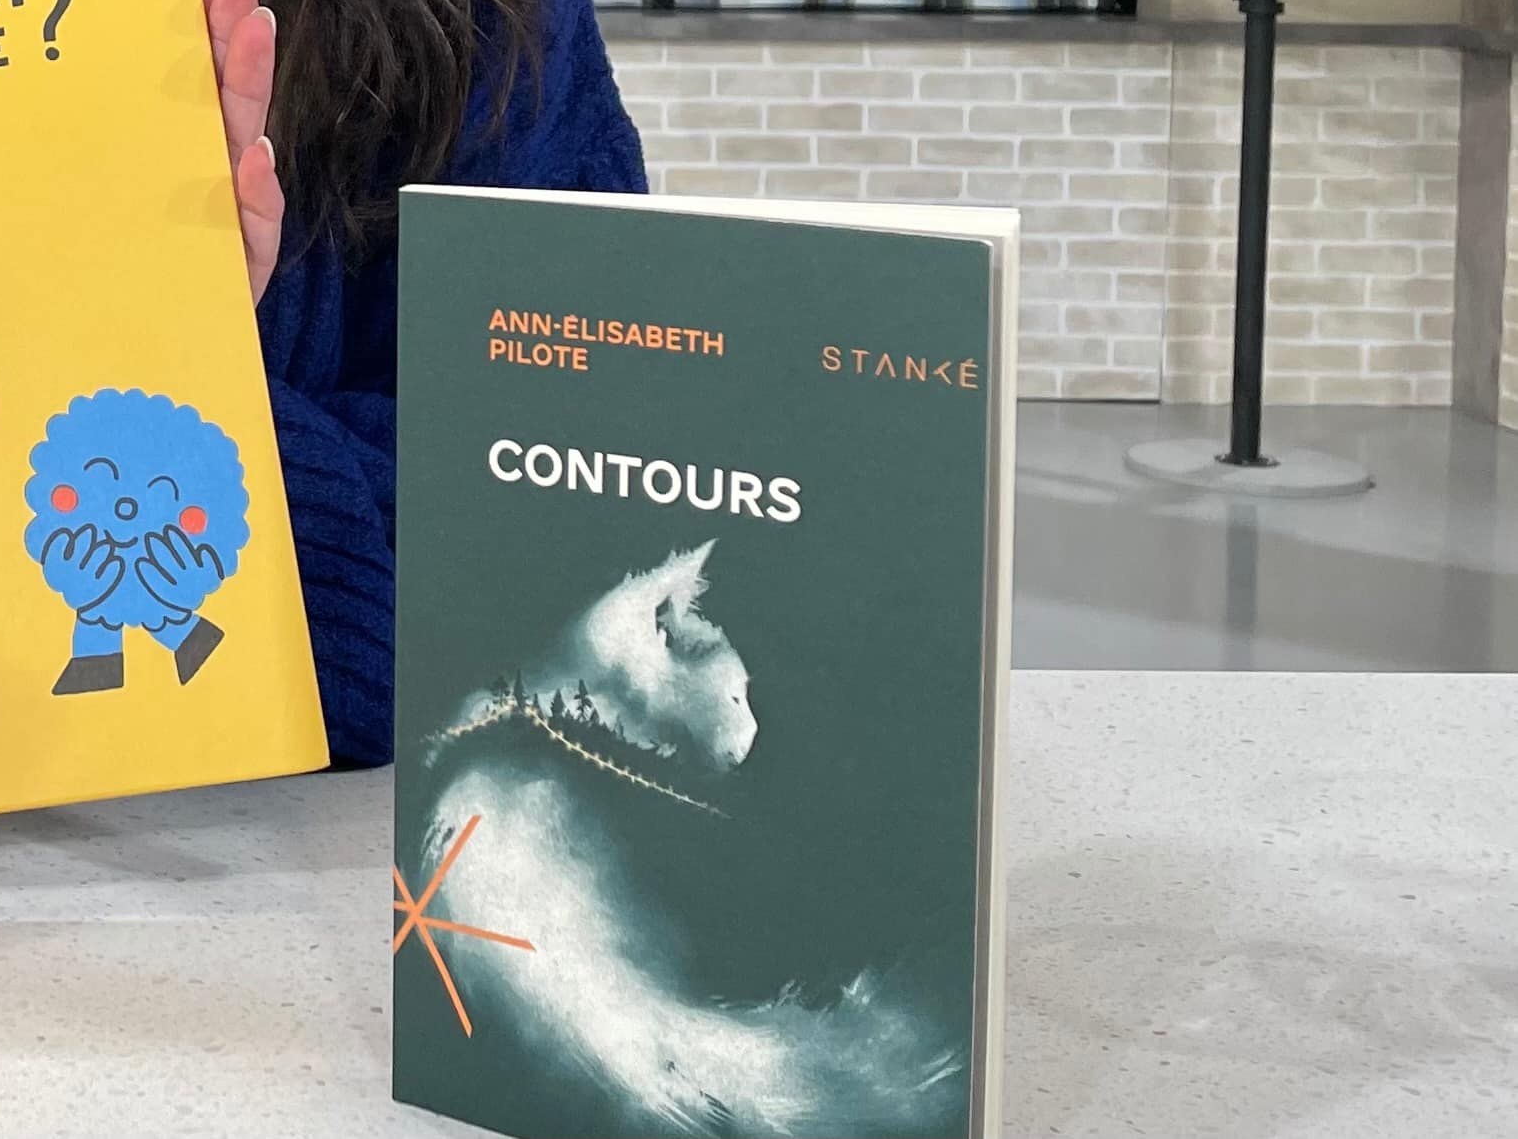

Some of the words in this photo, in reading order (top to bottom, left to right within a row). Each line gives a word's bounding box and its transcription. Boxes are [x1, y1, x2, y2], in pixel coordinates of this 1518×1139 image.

[488, 308, 725, 356] ANN-ÉLISABETH
[489, 338, 589, 370] PILOTE
[488, 438, 802, 522] CONTOURS
